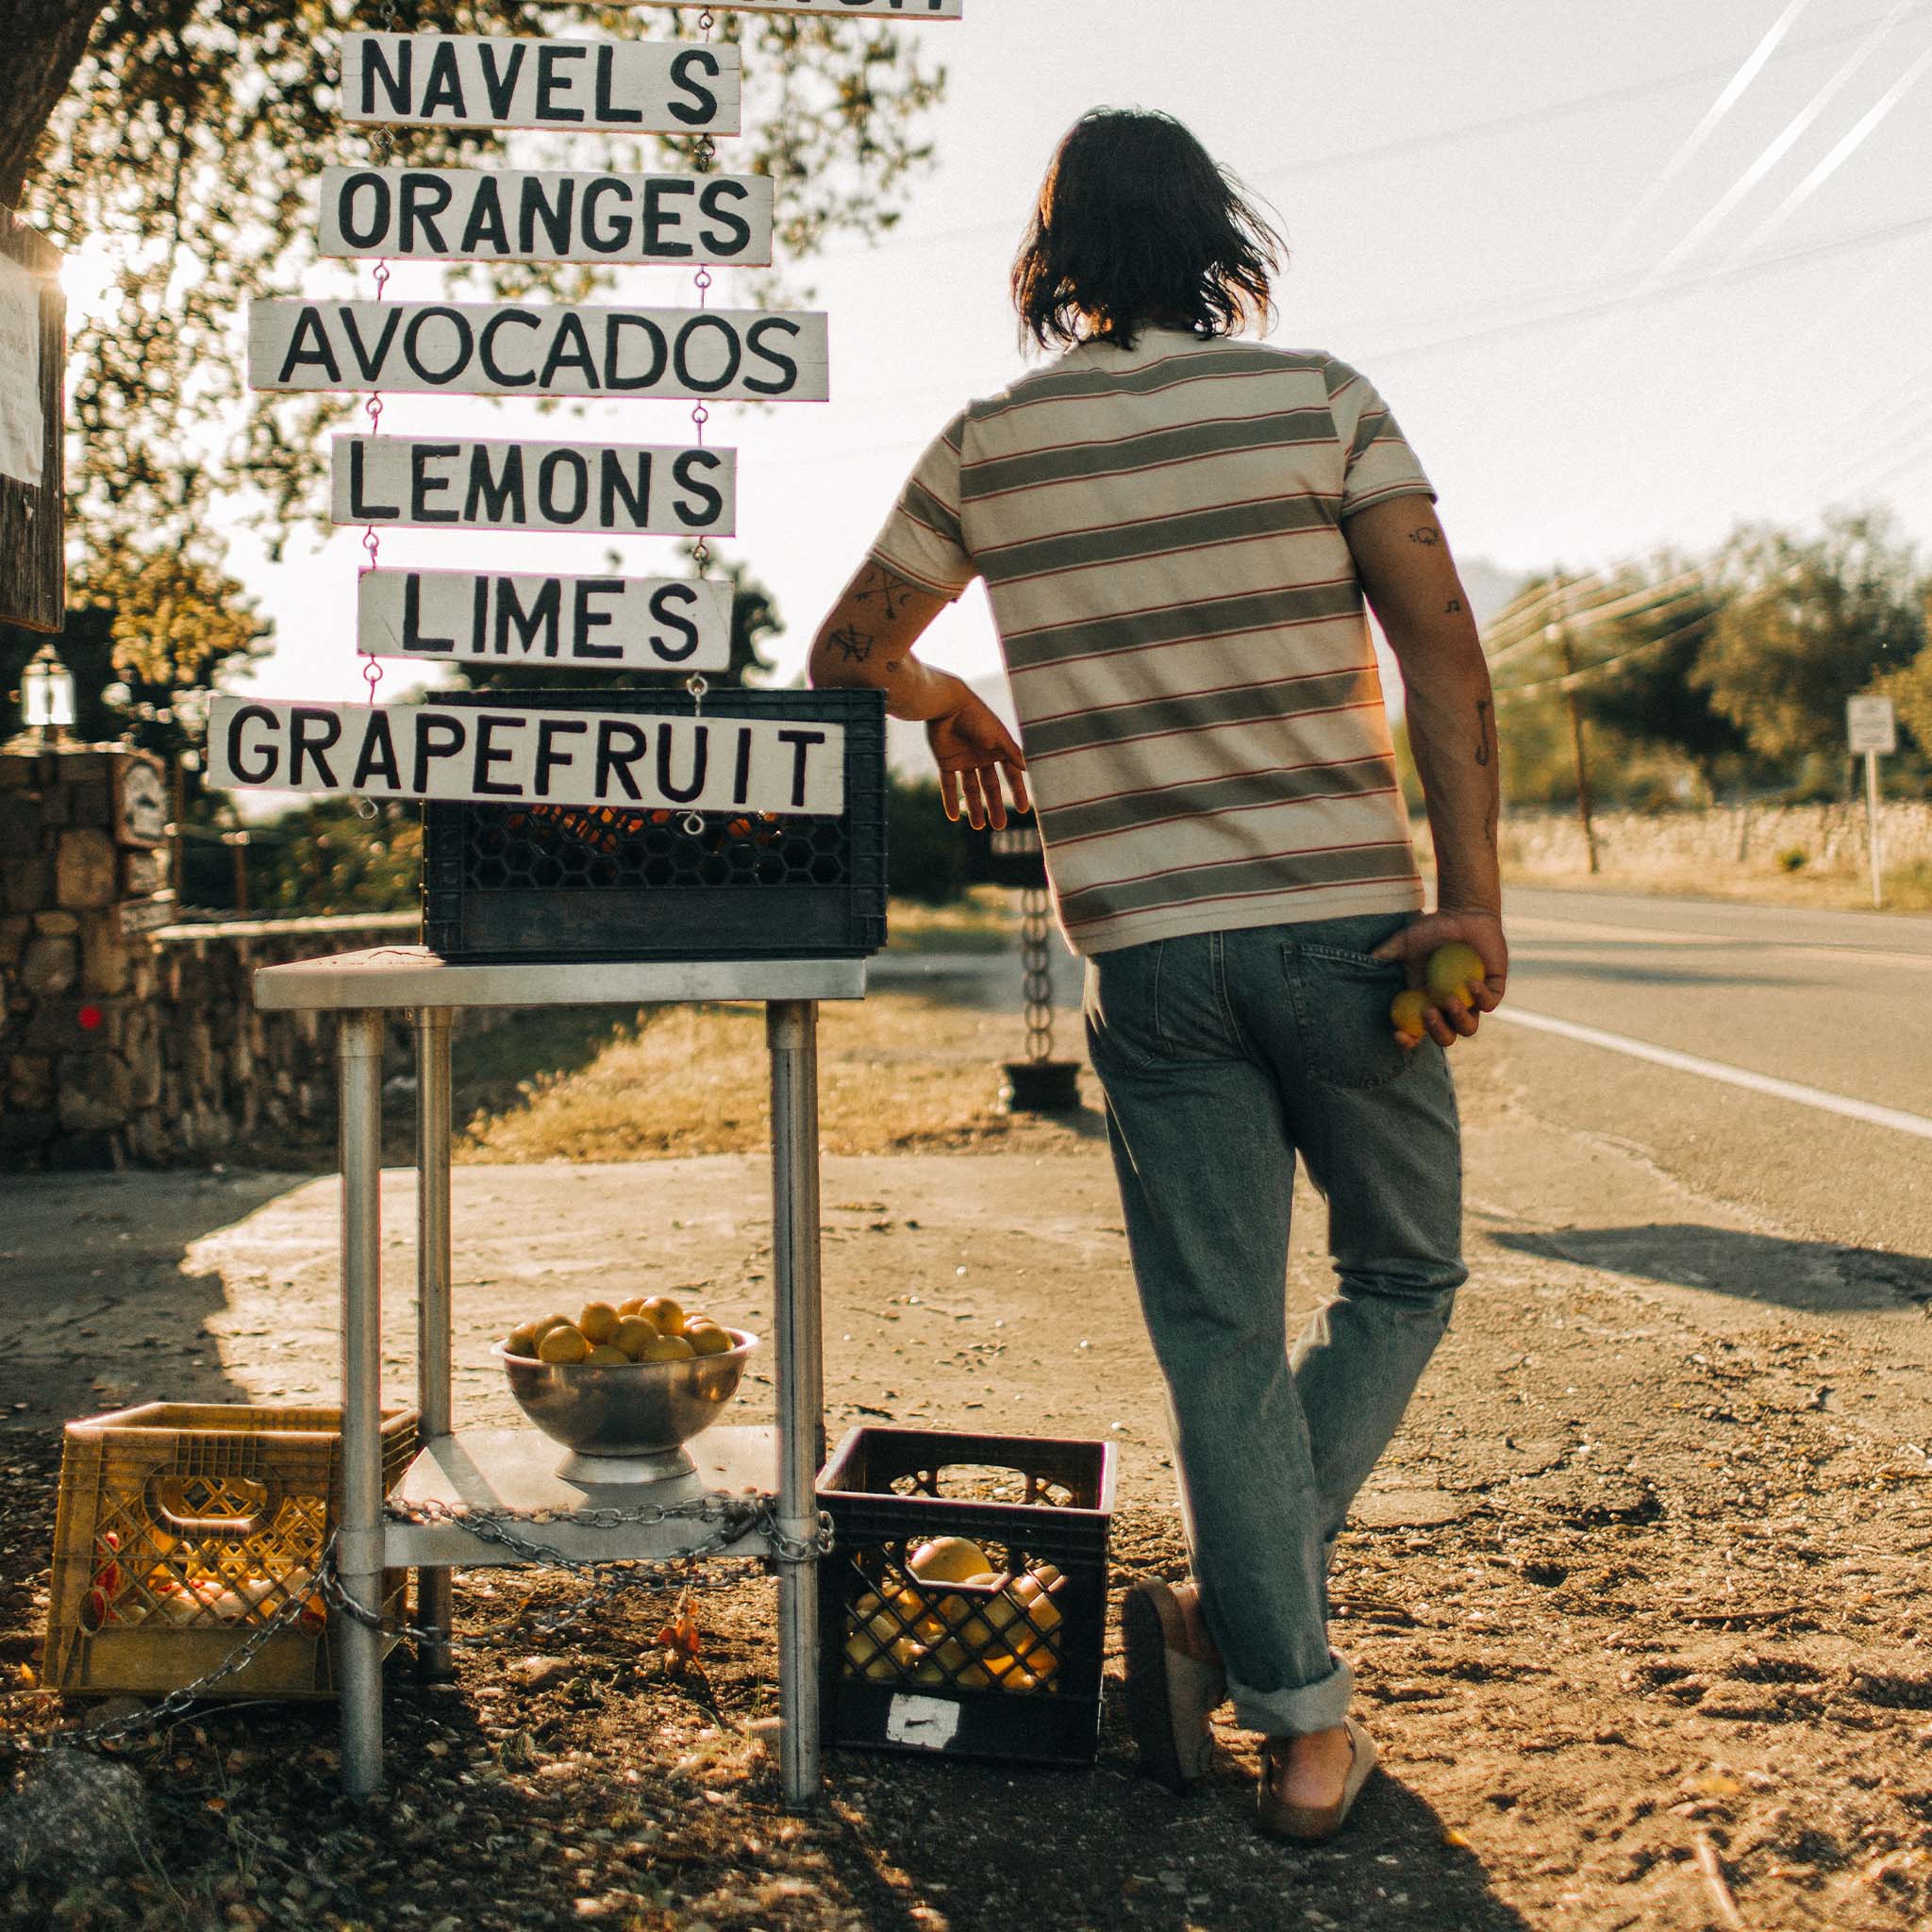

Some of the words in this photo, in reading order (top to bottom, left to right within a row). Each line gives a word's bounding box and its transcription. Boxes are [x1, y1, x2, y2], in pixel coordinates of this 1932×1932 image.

[338, 173, 750, 256] ORANGES
[278, 307, 800, 394] AVOCADOS
[350, 441, 723, 526] LEMONS
[402, 573, 698, 661] LIMES
[227, 706, 824, 807] GRAPEFRUIT
